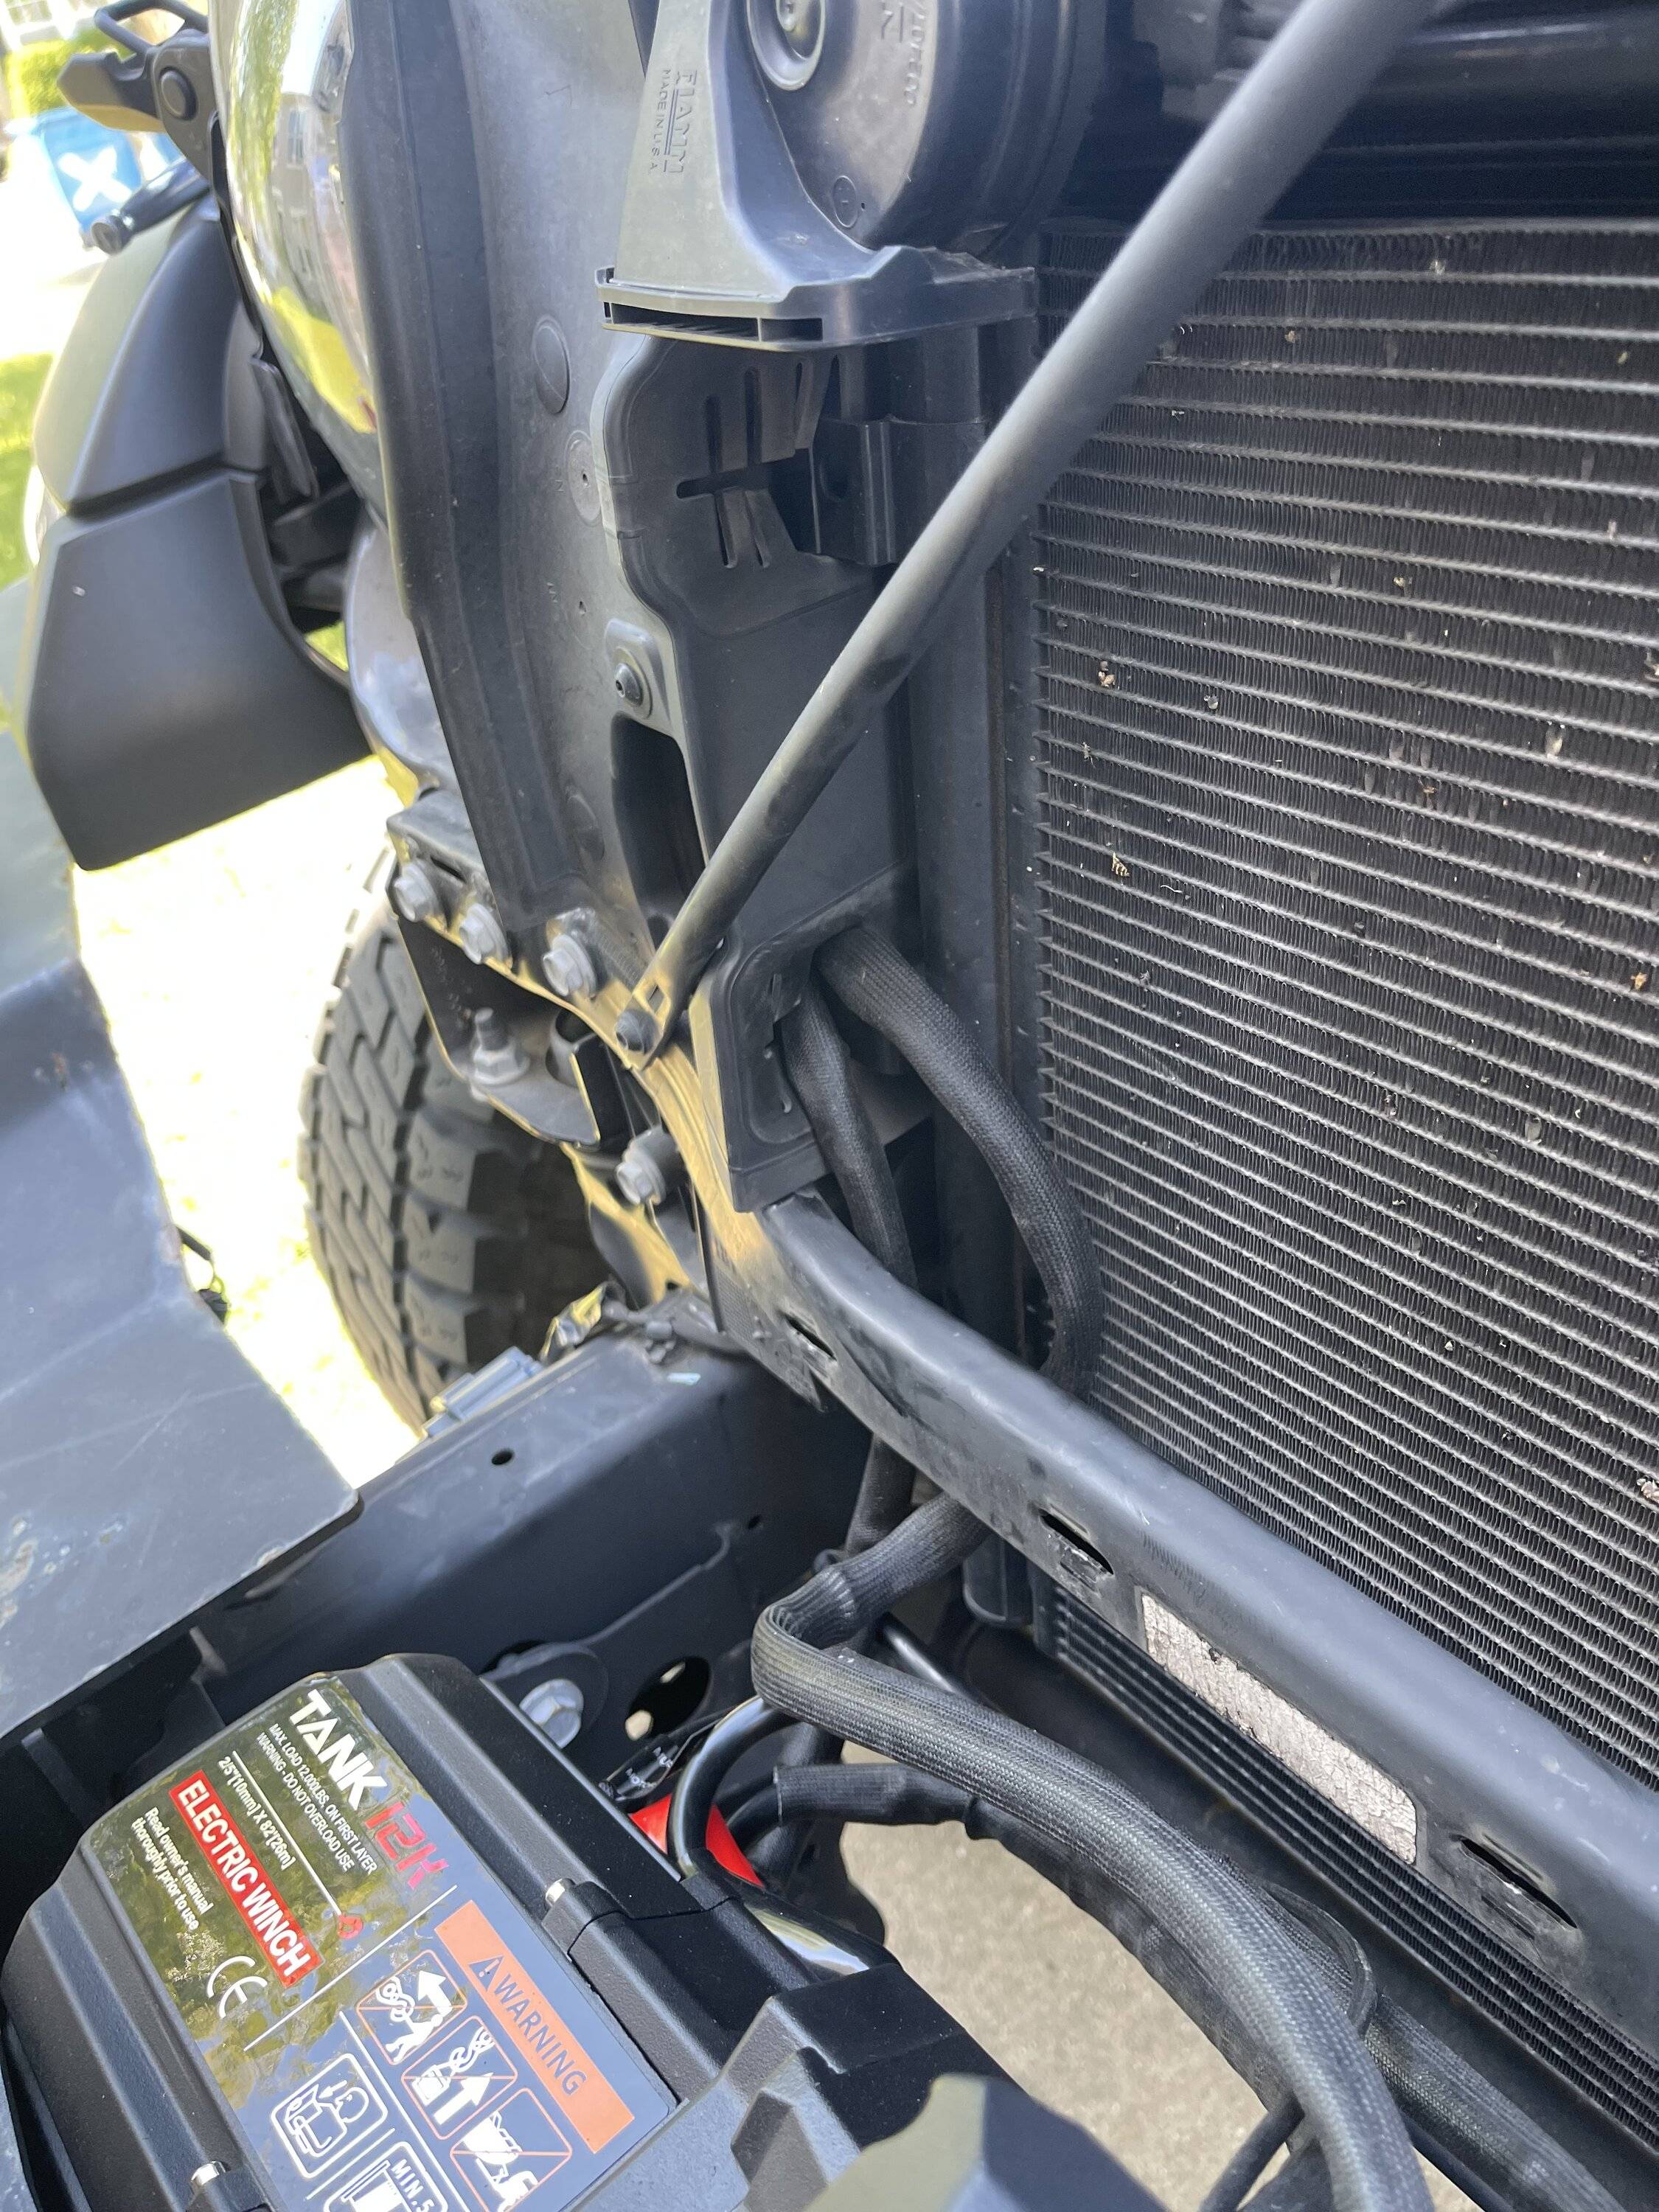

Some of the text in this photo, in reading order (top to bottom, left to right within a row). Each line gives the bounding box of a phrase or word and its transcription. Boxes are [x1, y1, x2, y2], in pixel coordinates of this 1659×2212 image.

[655, 114, 664, 129] IN
[658, 69, 671, 111] MADE
[664, 69, 698, 173] FIAMM
[257, 1732, 287, 1773] WARNING
[282, 1773, 299, 1788] DO
[293, 1787, 313, 1806] NOT
[304, 1803, 341, 1853] OVERLOAD
[334, 1849, 355, 1872] USE
[282, 1741, 303, 1767] LOAD
[325, 1803, 340, 1820] ON
[333, 1816, 357, 1841] FIRST
[350, 1837, 378, 1875] LAYER
[289, 1688, 449, 1890] TANK 12K
[131, 1817, 200, 1931] thoroughly prior to use
[145, 1806, 215, 1916] Read owner's manual
[178, 1779, 311, 1978] ELECTRIC WINCH
[207, 1955, 268, 2019] CE
[493, 1973, 588, 2096] WARNING
